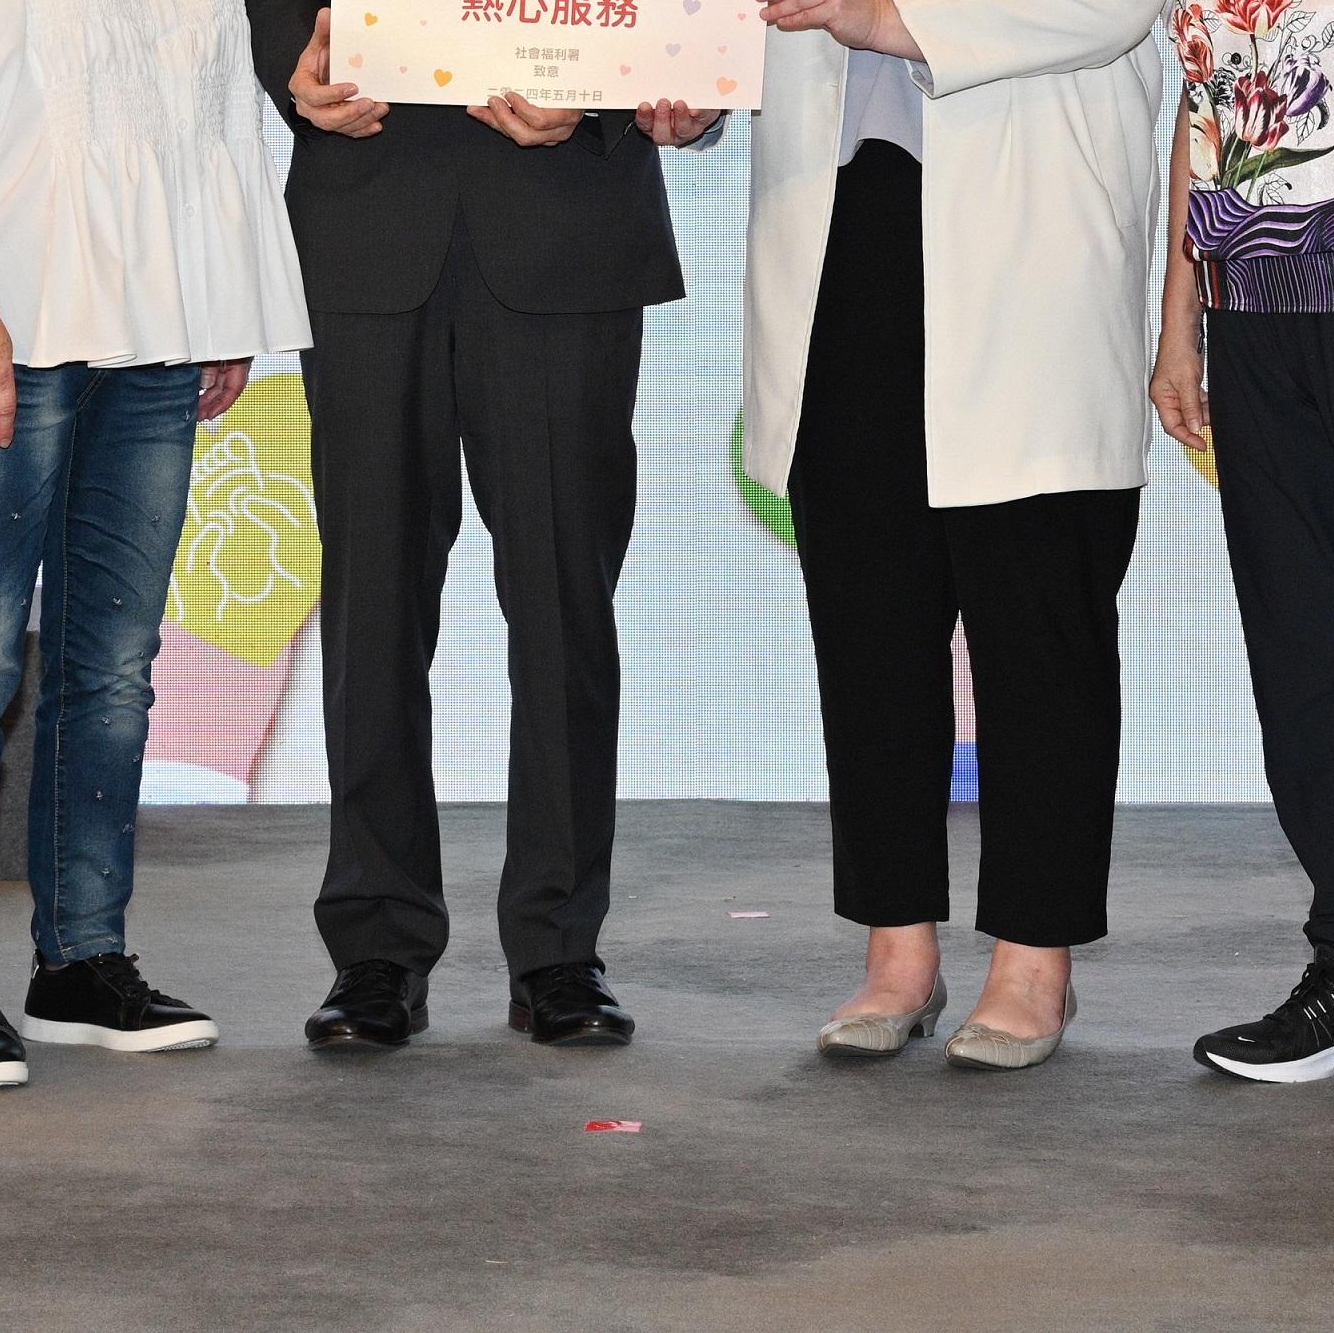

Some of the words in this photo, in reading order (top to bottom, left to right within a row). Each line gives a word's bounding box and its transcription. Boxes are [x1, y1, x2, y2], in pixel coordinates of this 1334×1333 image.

[514, 46, 580, 61] 社會福利署
[533, 64, 559, 78] 致意
